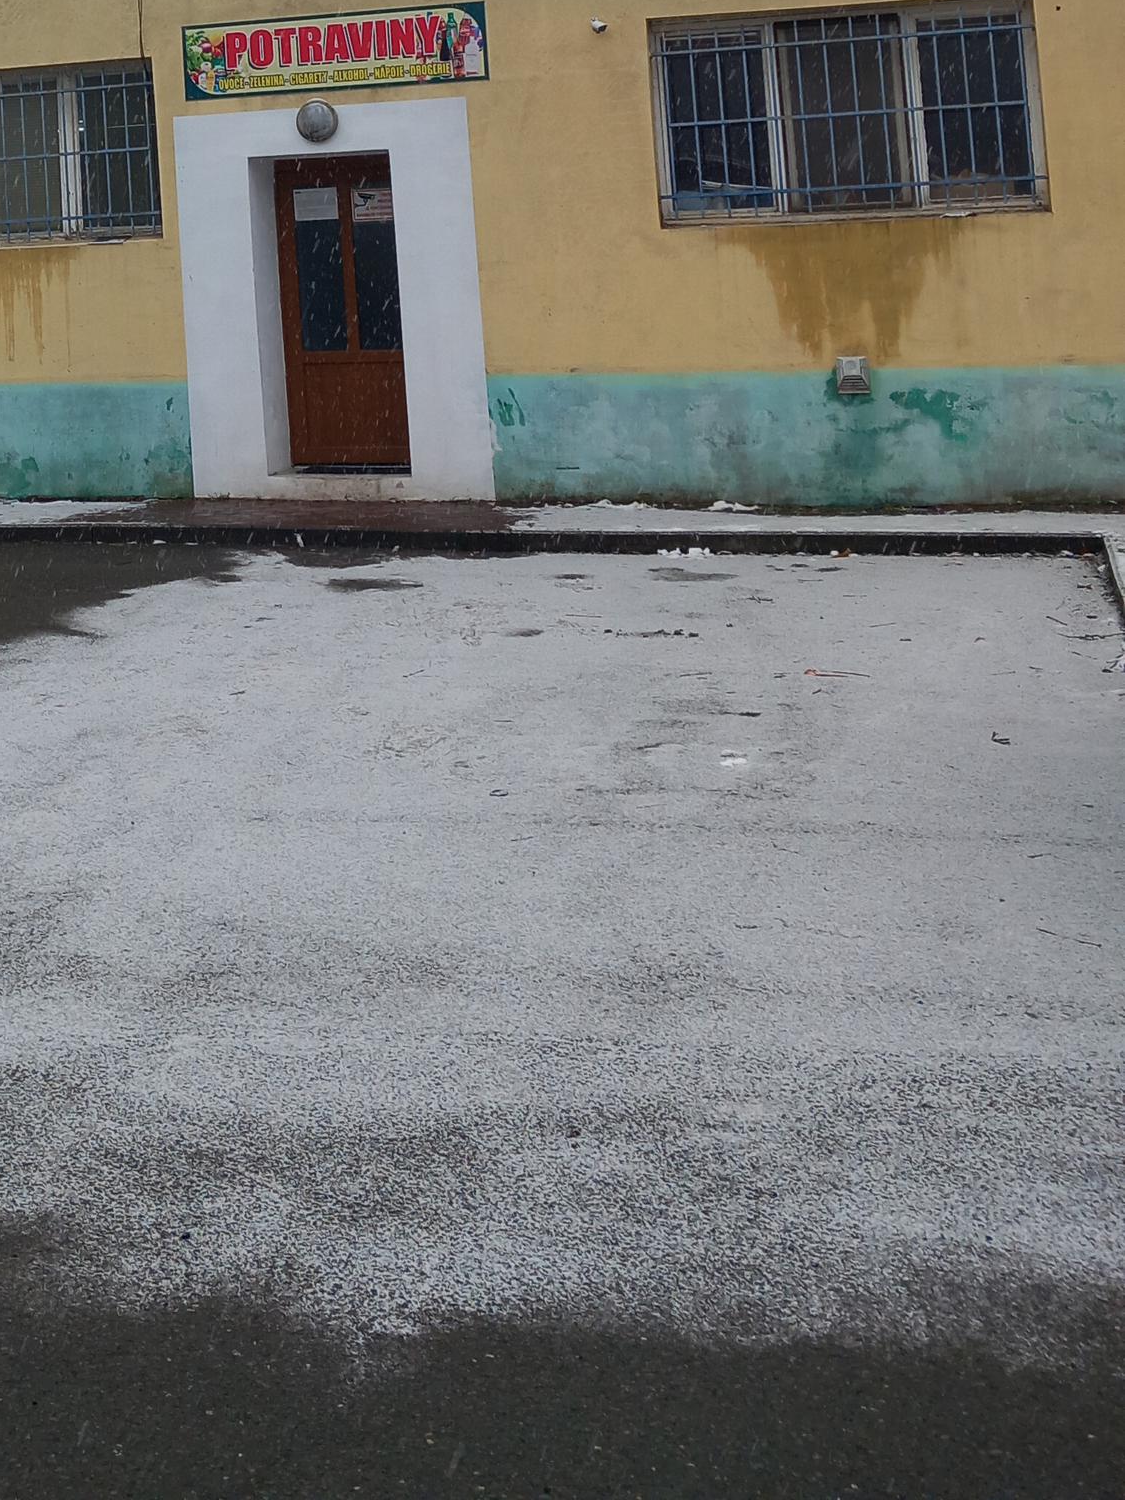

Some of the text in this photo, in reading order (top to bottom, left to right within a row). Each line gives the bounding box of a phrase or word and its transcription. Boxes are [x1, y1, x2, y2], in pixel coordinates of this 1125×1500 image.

[225, 15, 441, 70] POTRAVINY
[218, 75, 245, 91] OVOCE
[249, 74, 285, 88] ZELENINA
[290, 71, 328, 86] CIGARETY
[333, 68, 369, 83] ALKOHOL
[409, 62, 452, 78] DROGERIE
